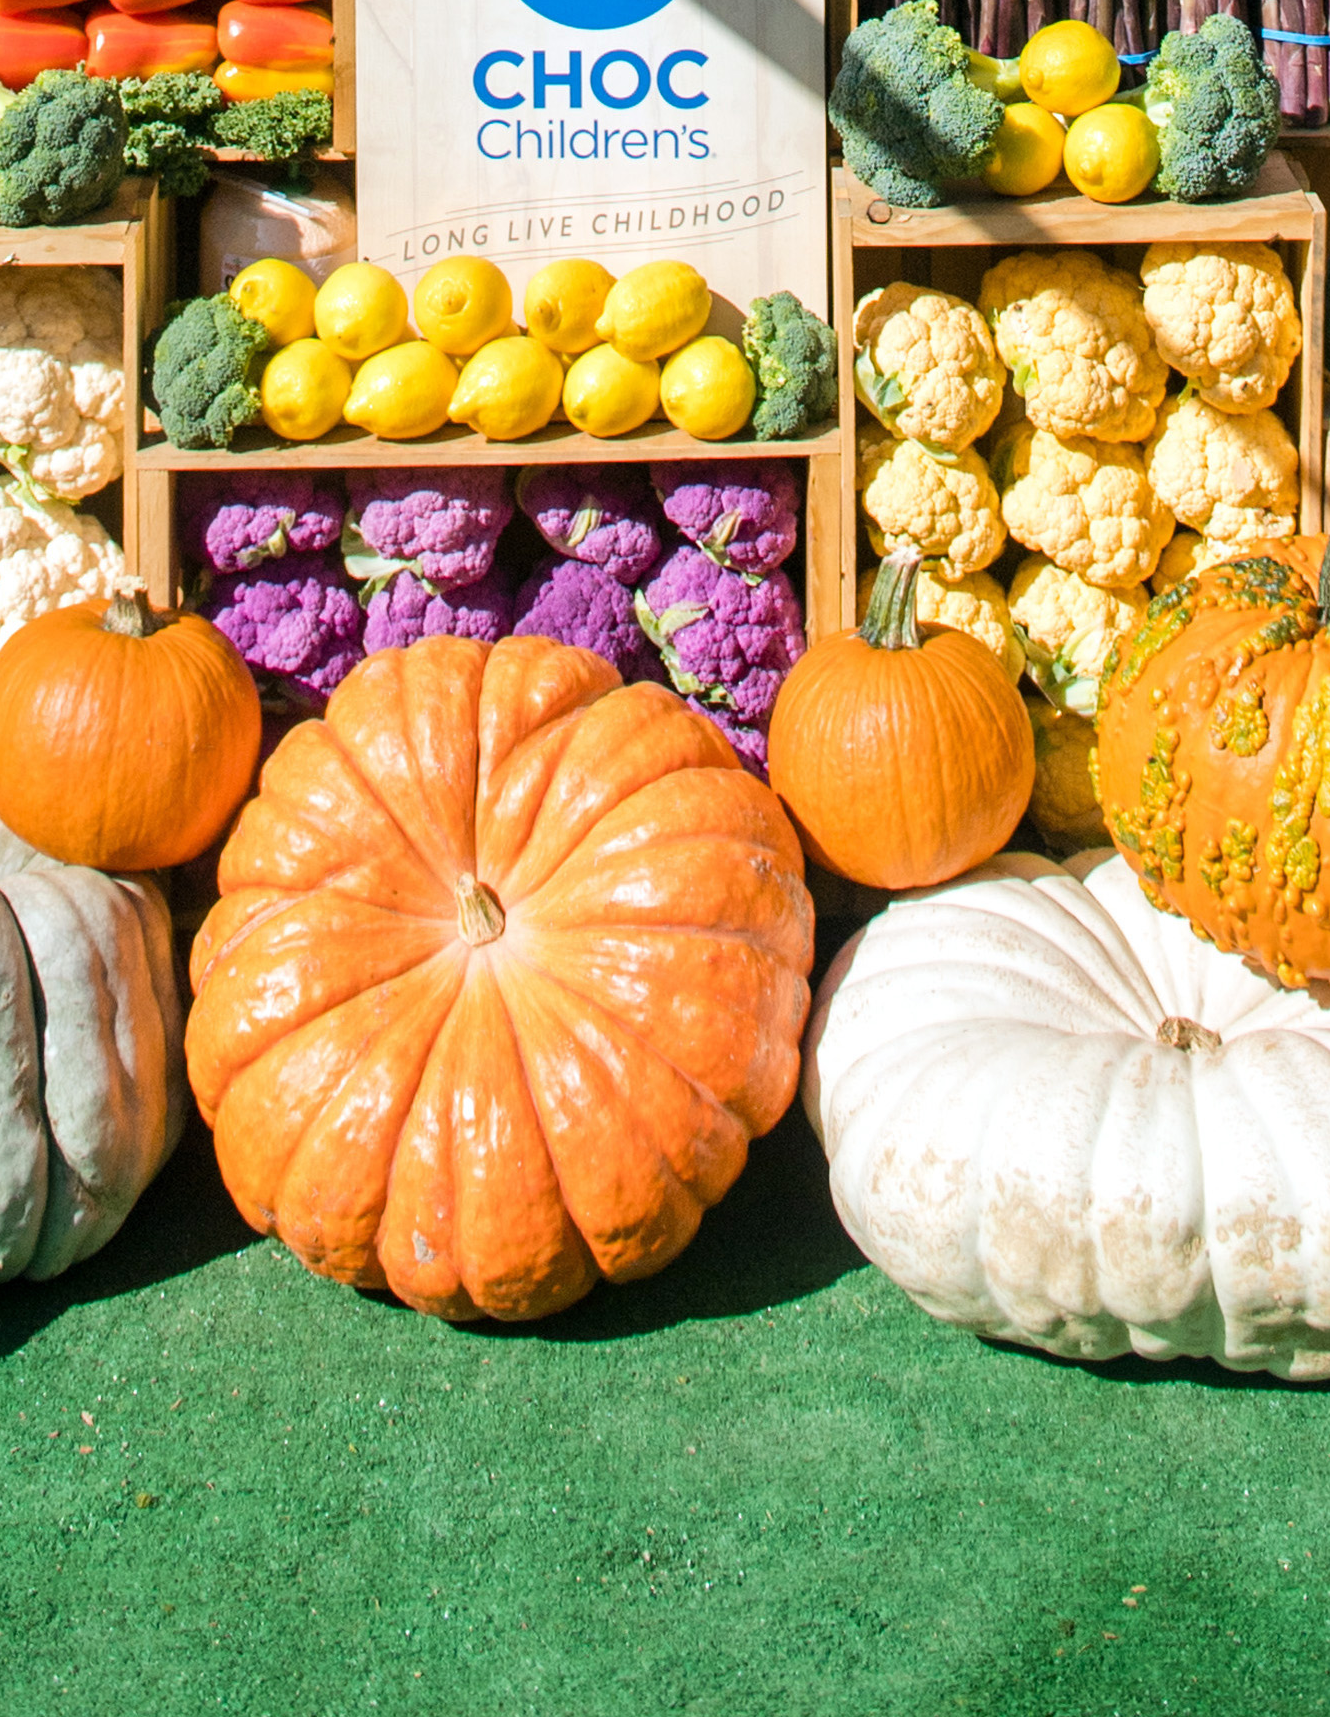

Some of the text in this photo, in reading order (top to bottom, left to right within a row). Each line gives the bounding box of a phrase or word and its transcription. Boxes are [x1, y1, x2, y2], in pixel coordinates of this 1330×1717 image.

[472, 49, 711, 110] CHOC
[477, 118, 710, 159] Children's
[403, 189, 786, 263] LONG LIVE CHILDHOOD
